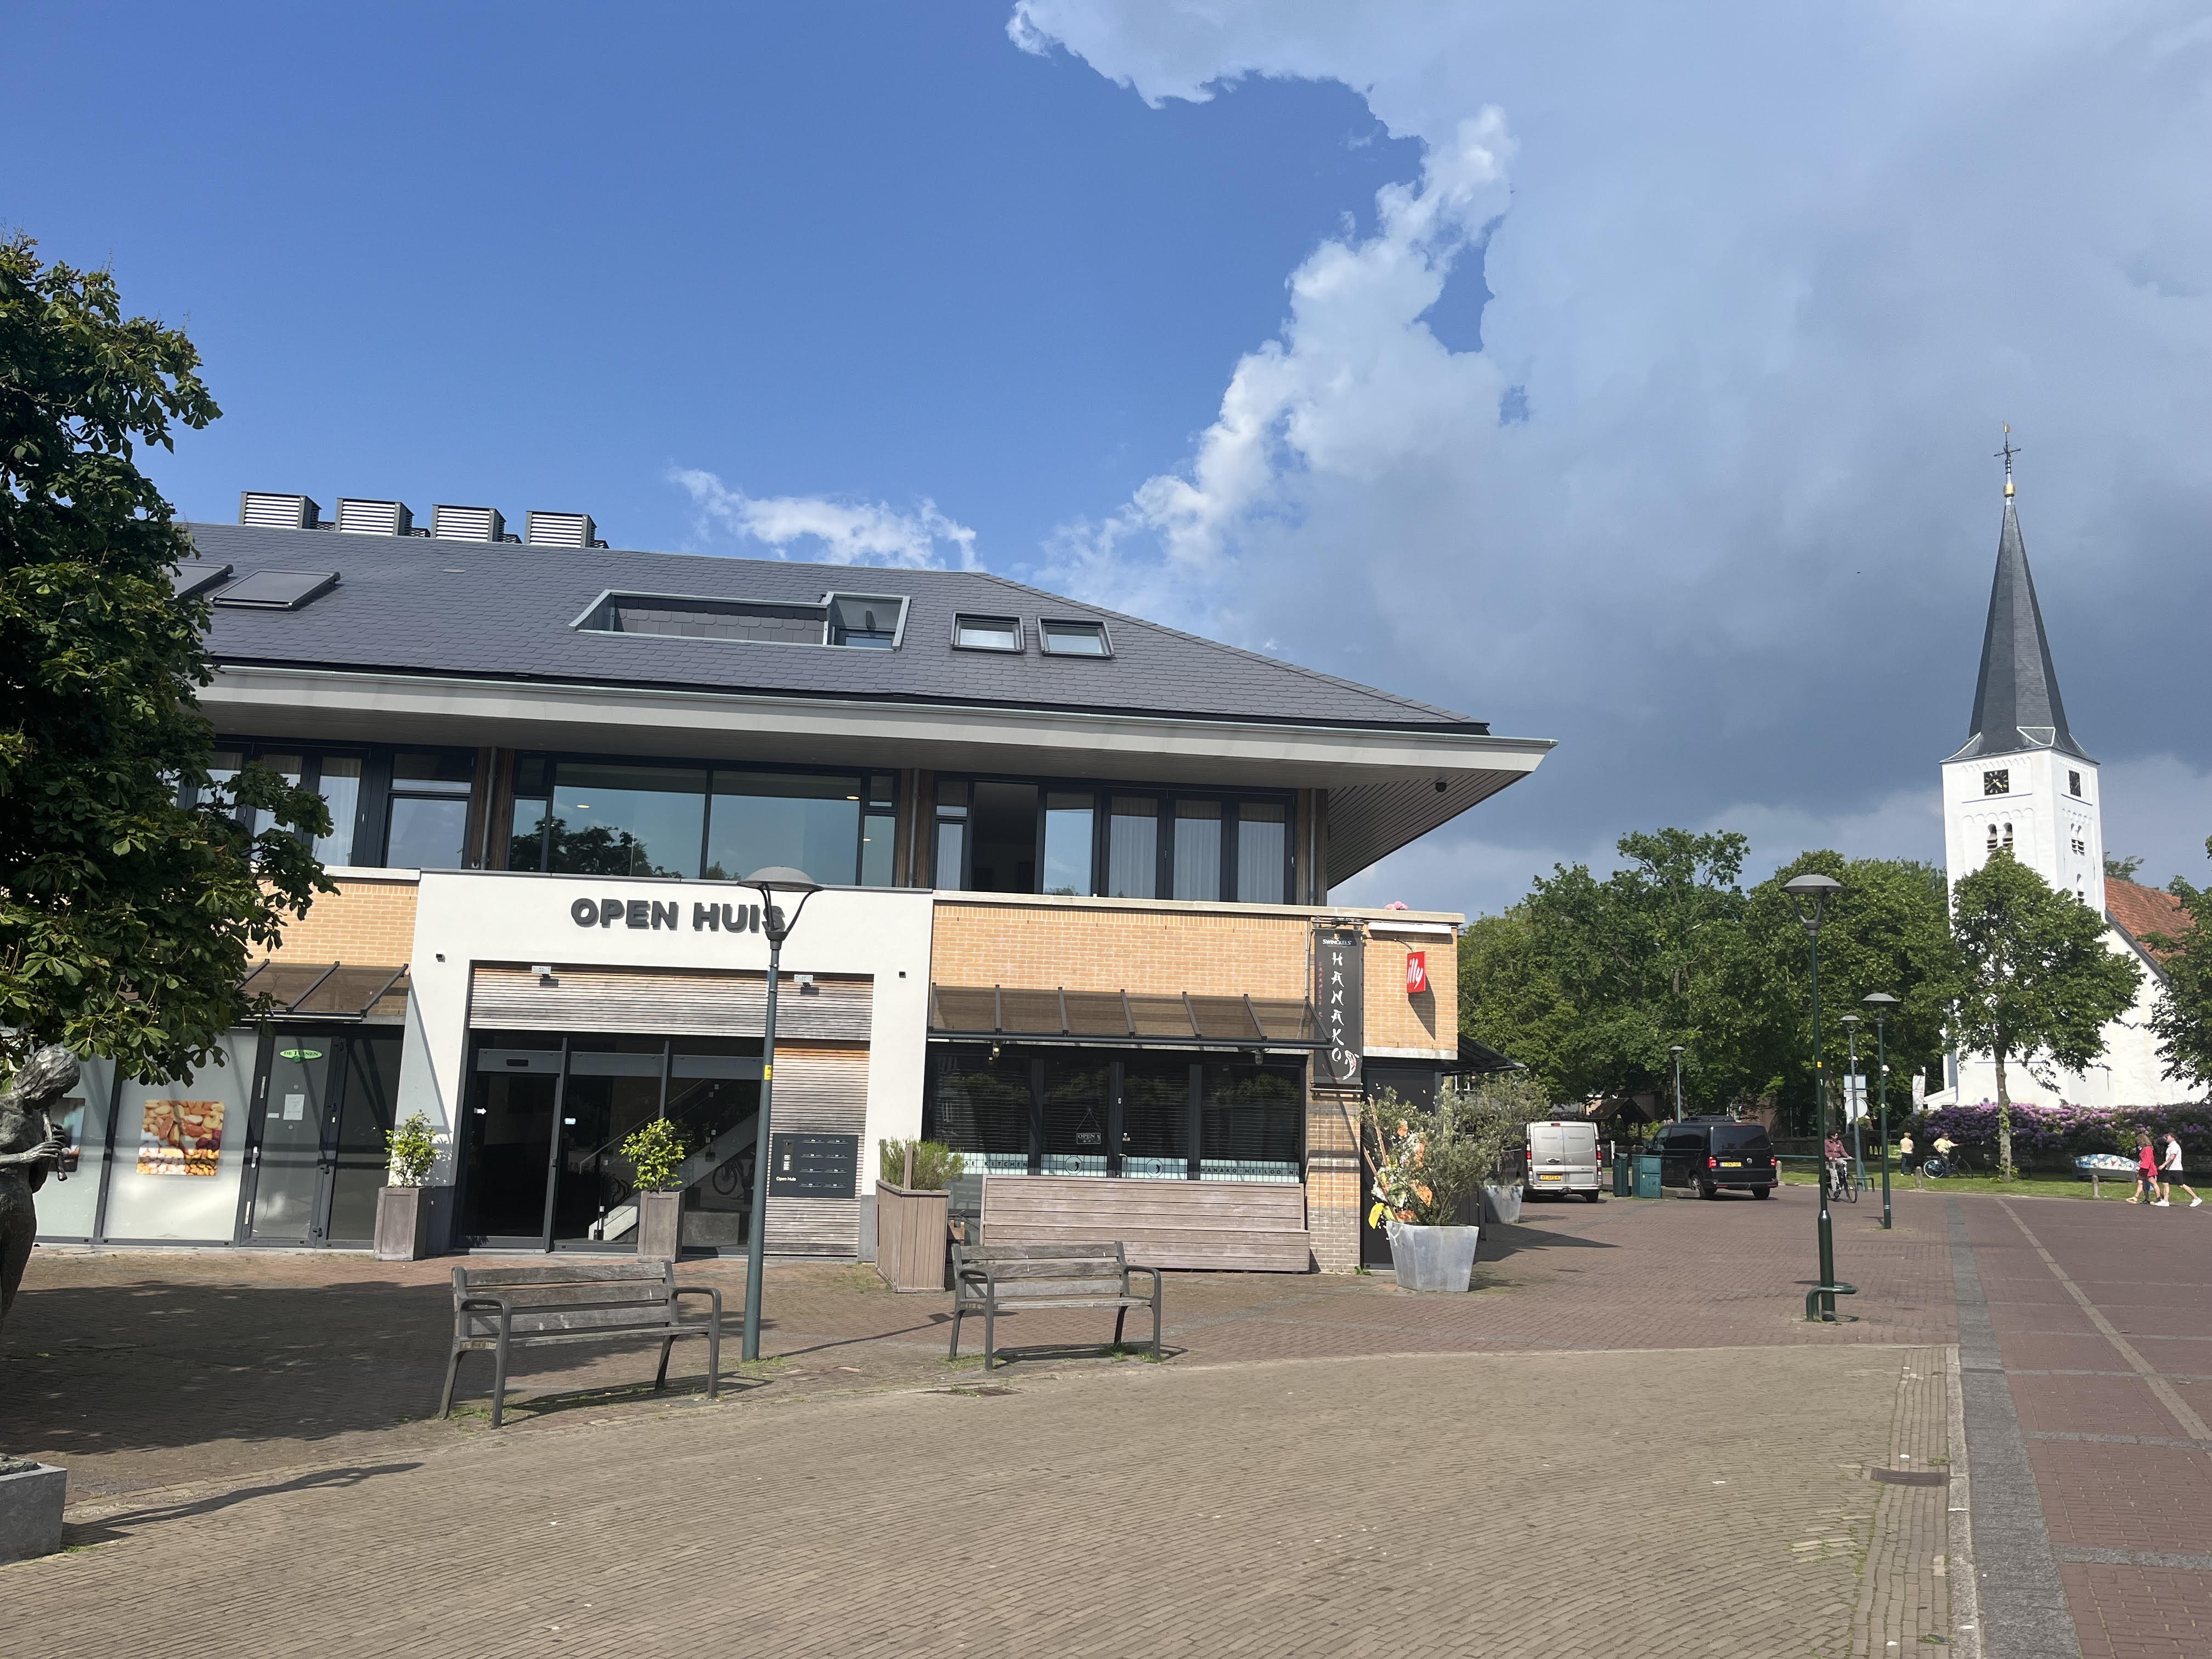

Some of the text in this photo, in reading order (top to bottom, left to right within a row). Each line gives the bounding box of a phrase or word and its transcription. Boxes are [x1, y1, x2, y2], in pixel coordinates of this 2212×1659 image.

[571, 898, 786, 933] OPEN HUIS
[1407, 958, 1424, 989] illy
[1330, 952, 1345, 1062] HANAKO
